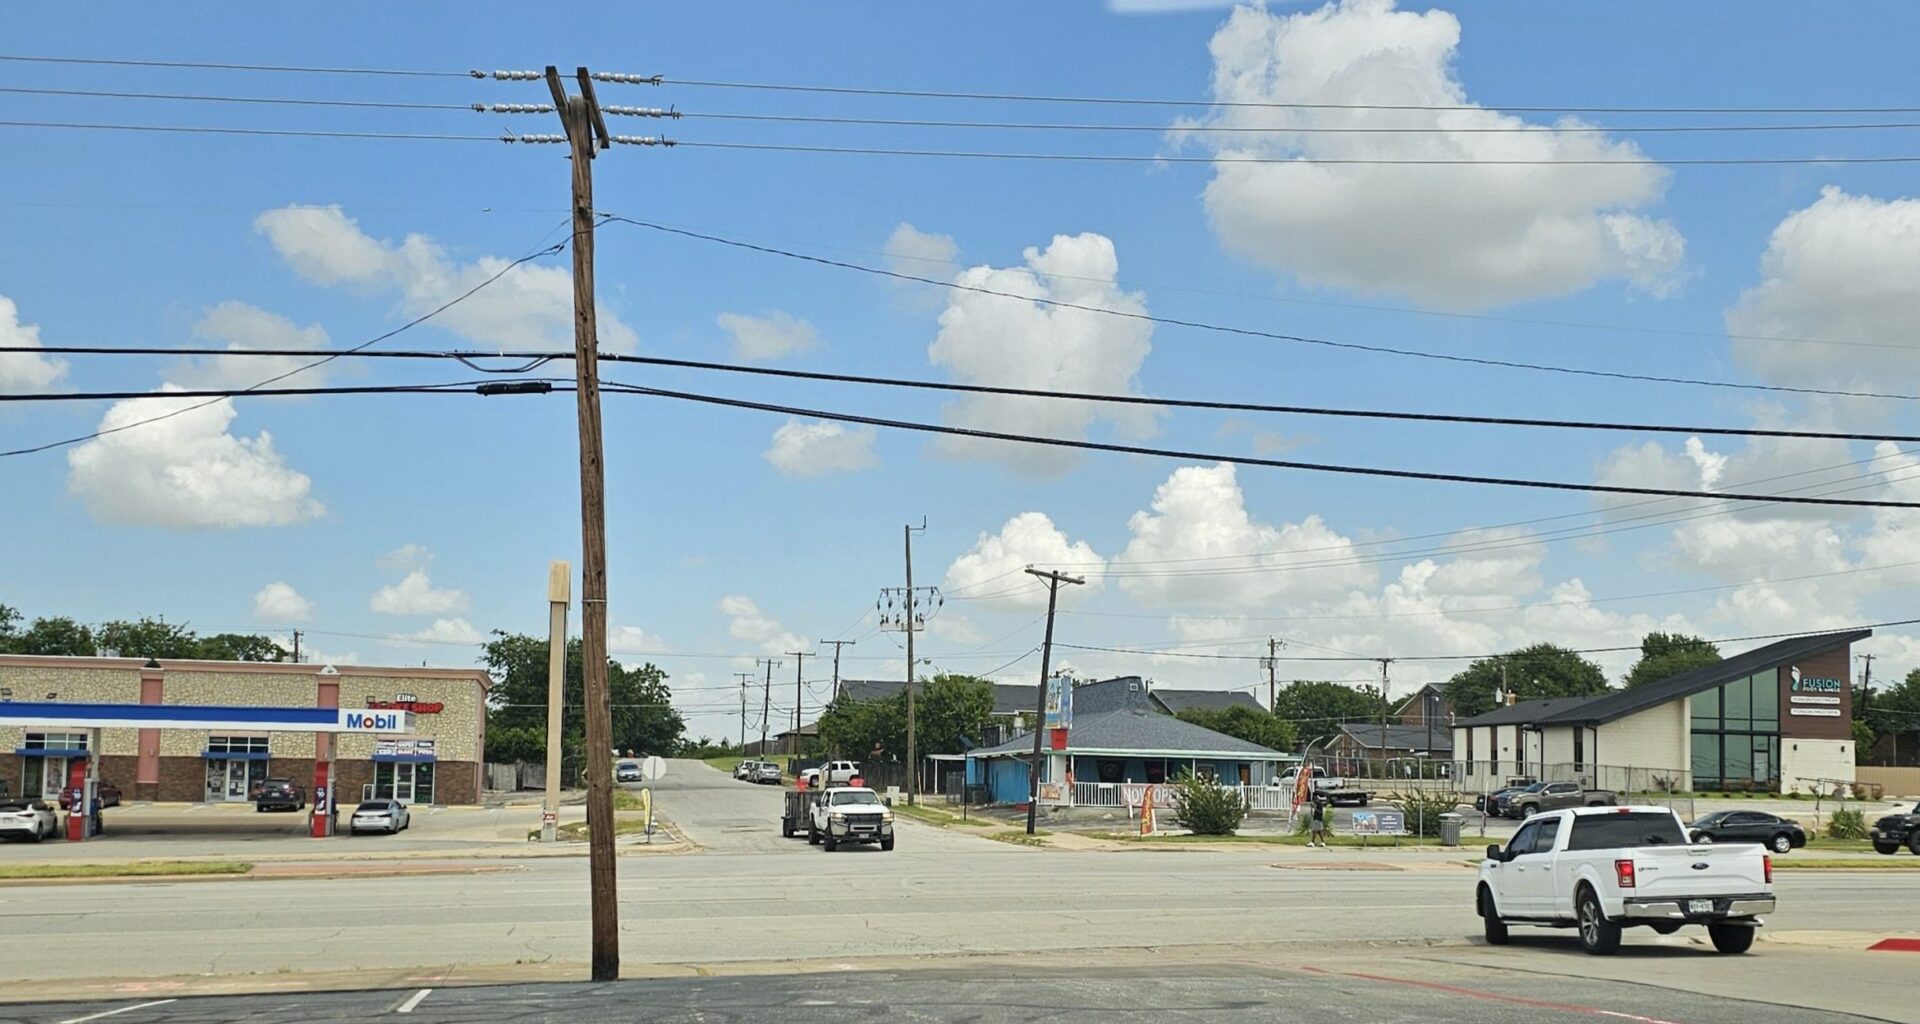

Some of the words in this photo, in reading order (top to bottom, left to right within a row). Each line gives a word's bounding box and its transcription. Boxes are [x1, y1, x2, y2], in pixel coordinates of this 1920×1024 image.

[1803, 678, 1840, 688] FUSION
[396, 694, 417, 702] Elite
[411, 703, 443, 714] SHOP
[347, 713, 396, 729] Mobil
